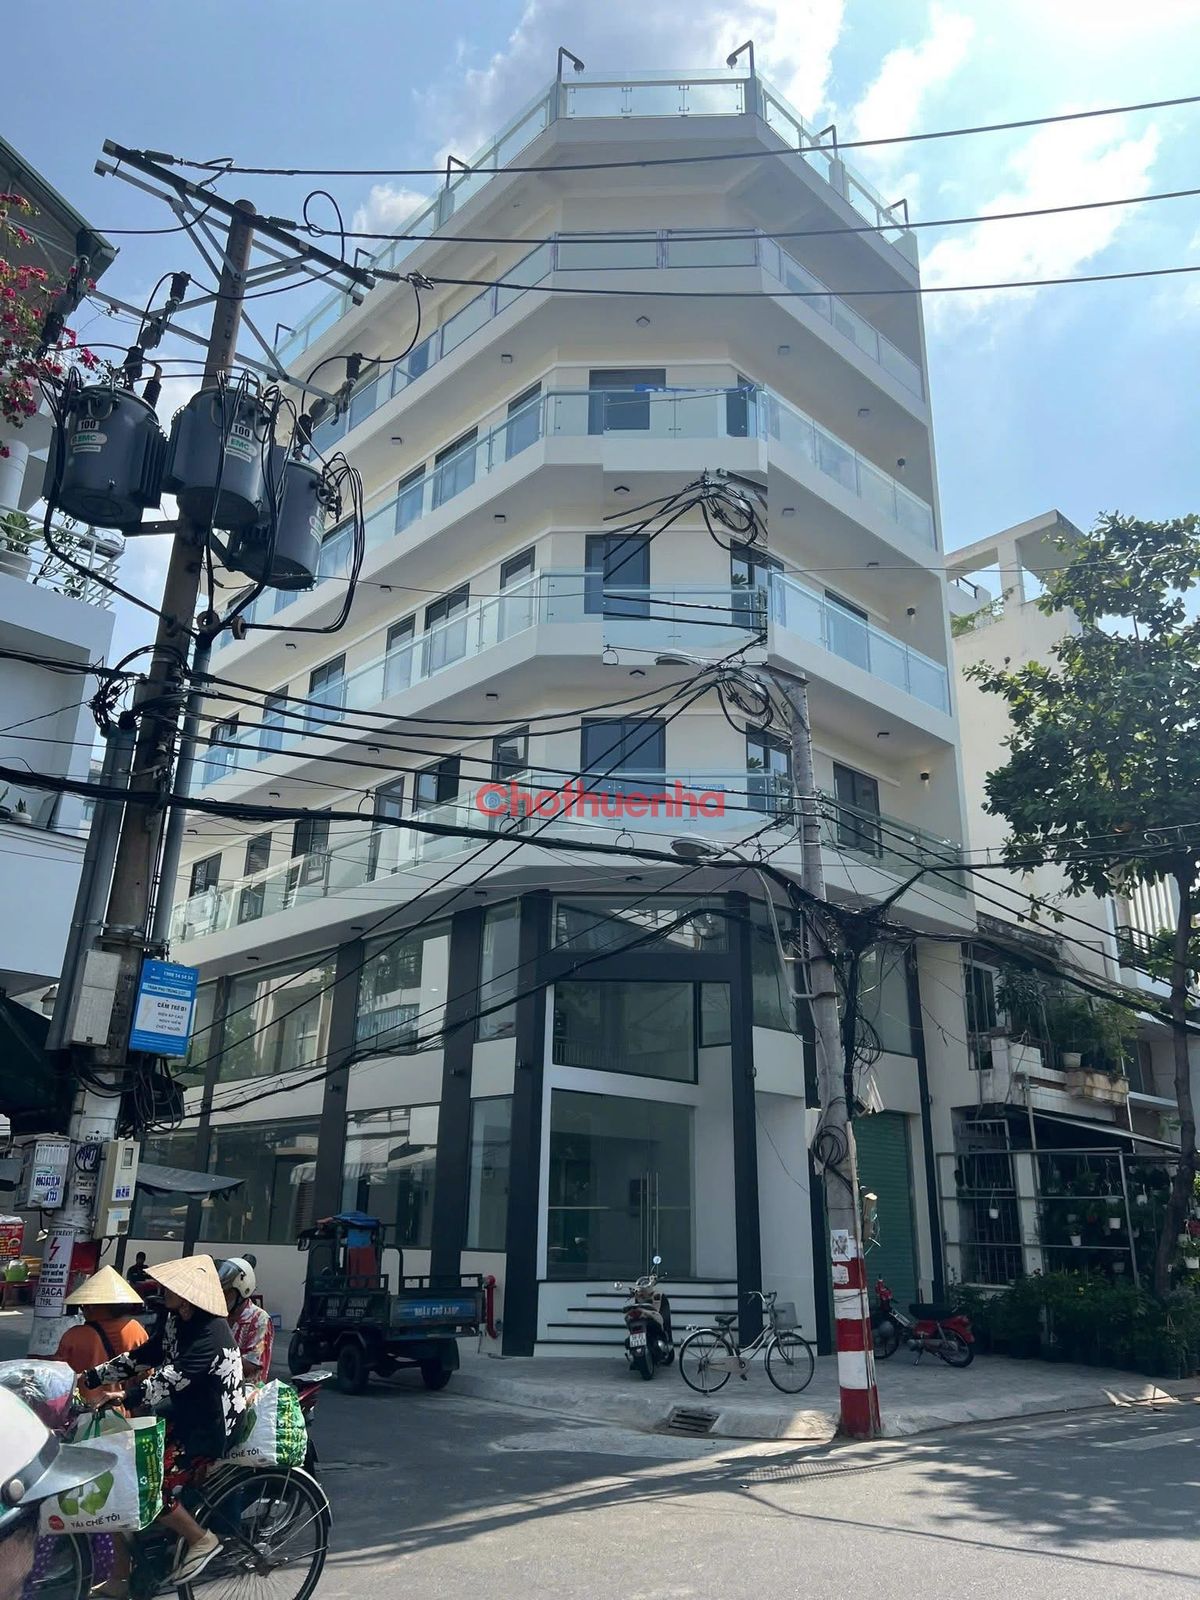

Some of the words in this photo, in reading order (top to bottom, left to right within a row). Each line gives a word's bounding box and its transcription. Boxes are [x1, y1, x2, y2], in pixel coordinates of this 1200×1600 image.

[81, 420, 96, 429] 100
[234, 425, 250, 437] 100
[78, 434, 97, 442] EMC
[231, 438, 249, 450] EMC
[246, 1448, 259, 1456] TÔI
[85, 1515, 104, 1527] CHẾ
[105, 1512, 120, 1523] TÔI
